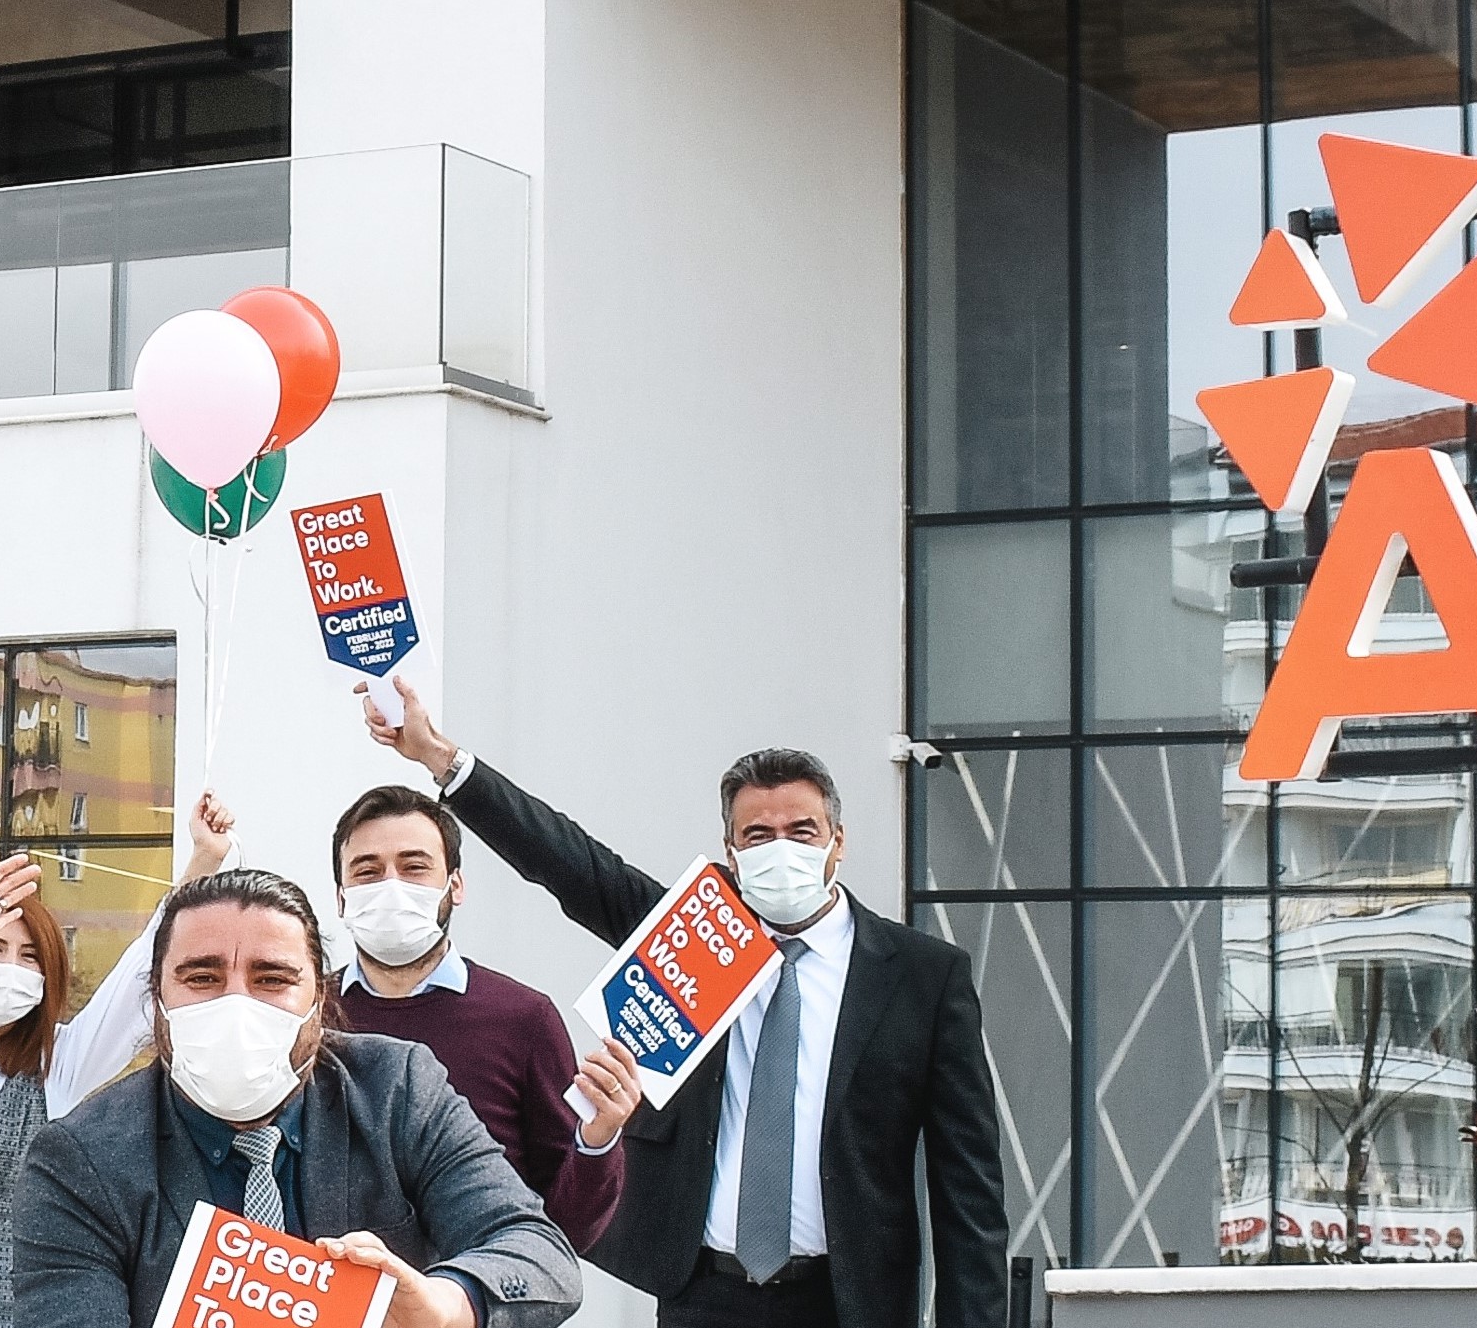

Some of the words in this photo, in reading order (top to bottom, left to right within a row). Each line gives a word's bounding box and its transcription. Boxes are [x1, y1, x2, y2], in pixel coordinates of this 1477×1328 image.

[298, 504, 364, 534] Great
[305, 529, 369, 558] Place
[309, 560, 337, 581] To
[325, 602, 407, 635] Certified
[664, 913, 689, 949] To
[680, 894, 735, 967] Place
[698, 876, 755, 949] Great
[624, 964, 695, 1051] Certified
[215, 1221, 336, 1293] Great
[203, 1256, 319, 1328] Place
